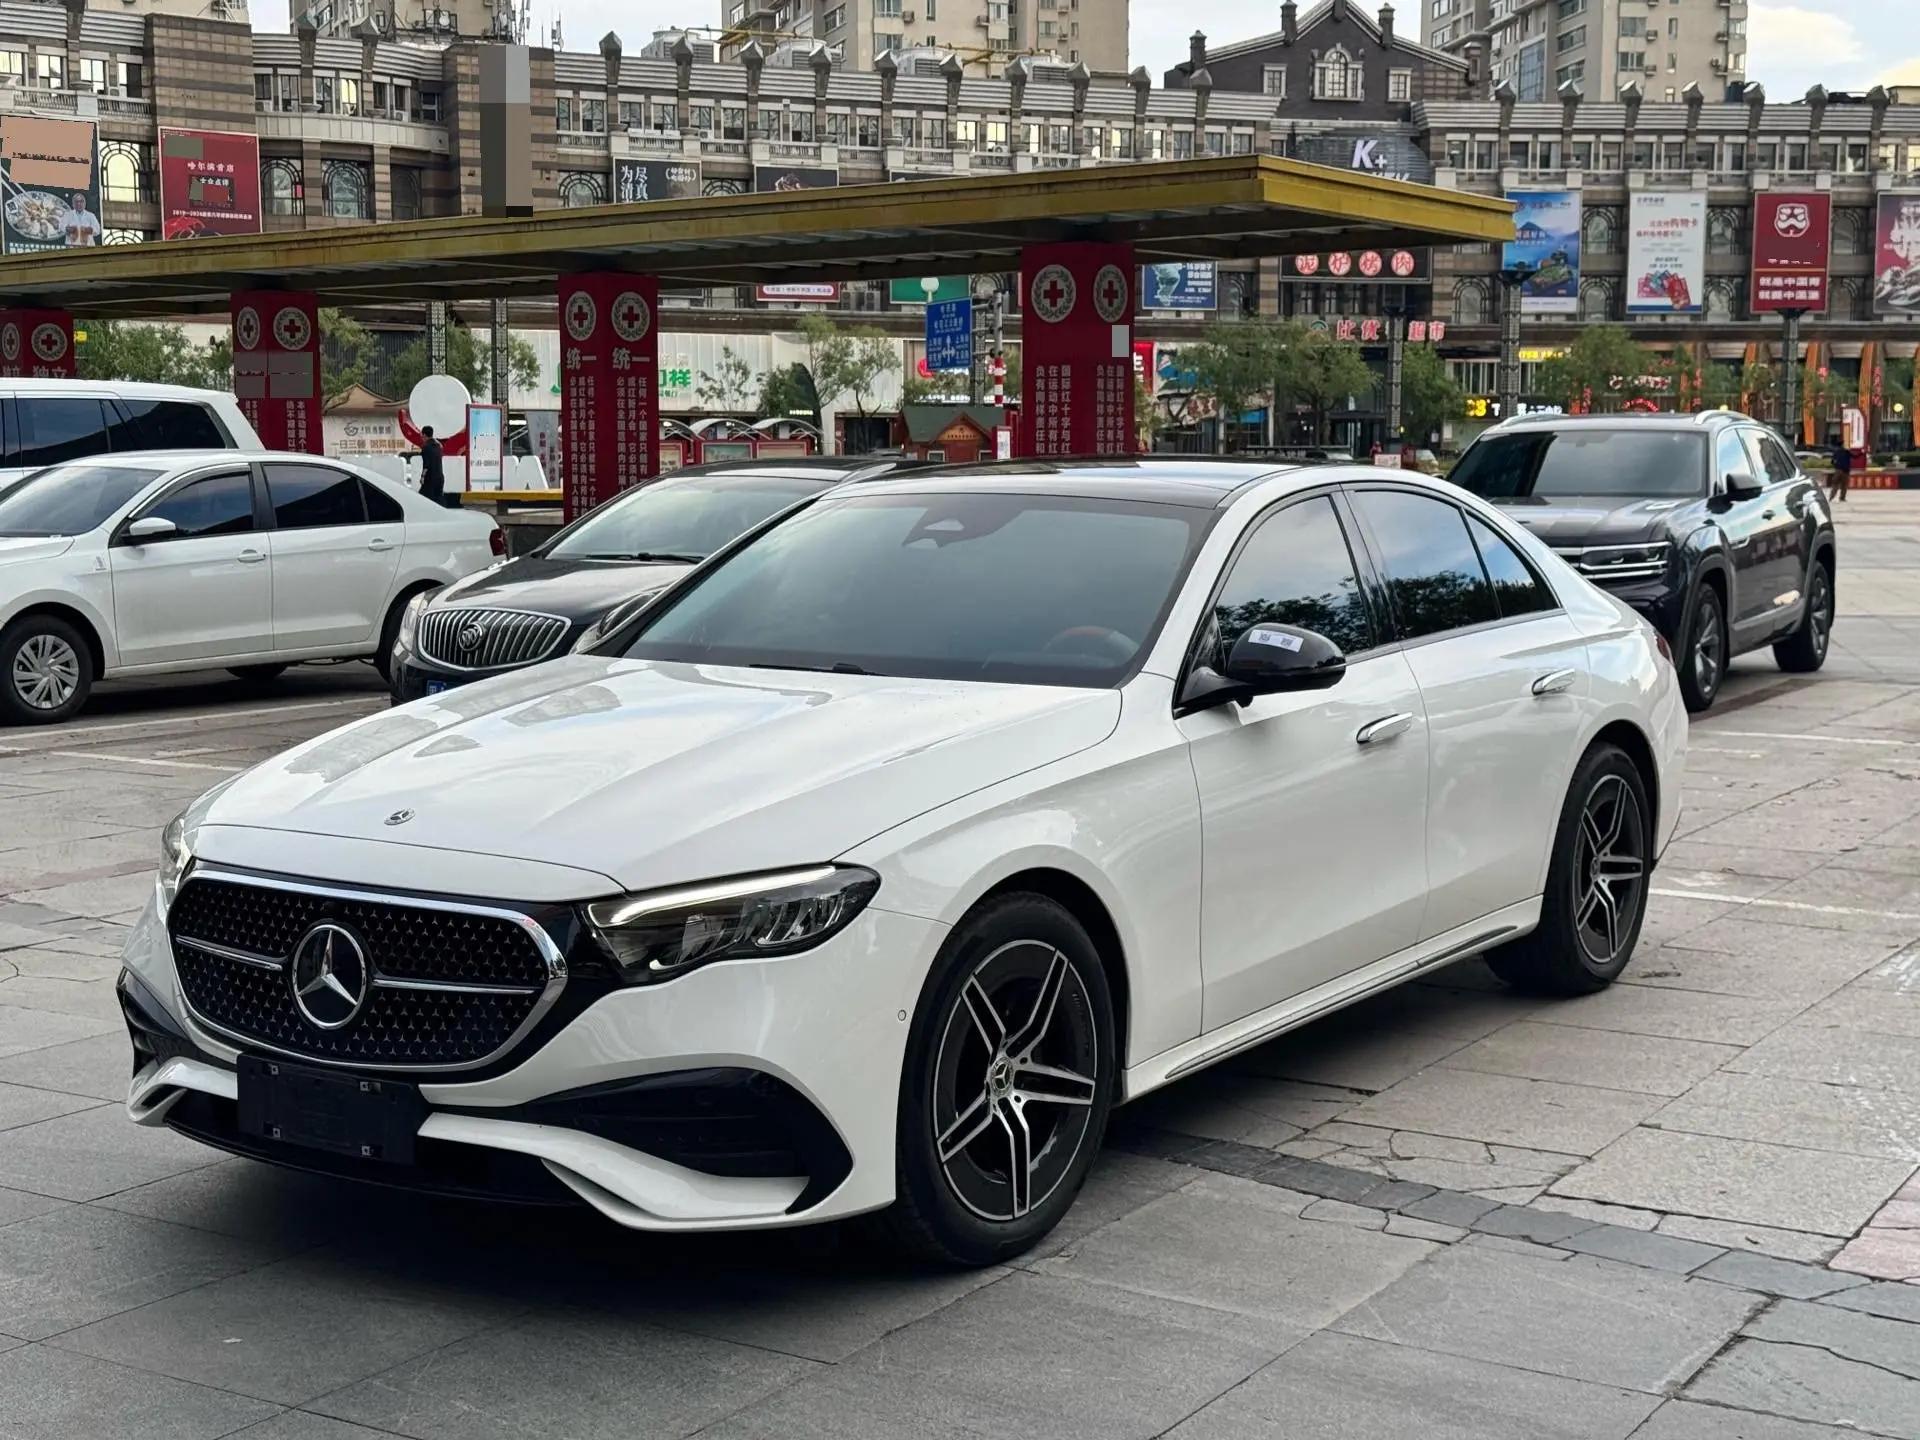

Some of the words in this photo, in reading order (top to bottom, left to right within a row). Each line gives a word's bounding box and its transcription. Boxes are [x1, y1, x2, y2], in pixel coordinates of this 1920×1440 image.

[1336, 320, 1446, 342] 比优超市
[566, 347, 597, 370] 统一
[612, 347, 650, 370] 统一
